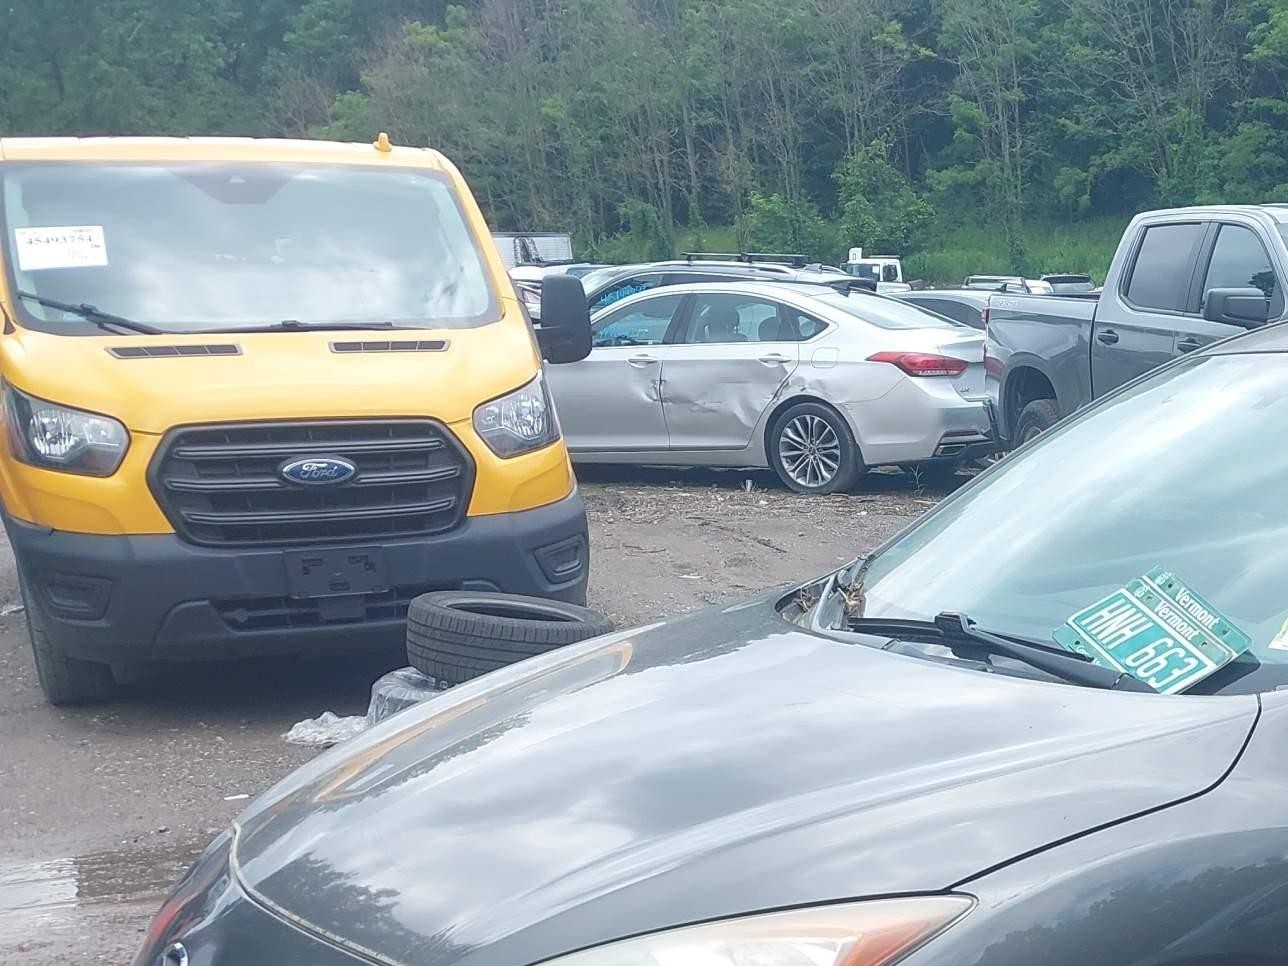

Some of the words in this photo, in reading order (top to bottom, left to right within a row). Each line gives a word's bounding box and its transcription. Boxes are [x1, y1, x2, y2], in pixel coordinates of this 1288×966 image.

[300, 462, 338, 479] Ford
[1153, 599, 1201, 641] Vermont
[1175, 586, 1221, 630] Vermont
[1080, 597, 1154, 650] HNH
[1125, 637, 1199, 689] 663
